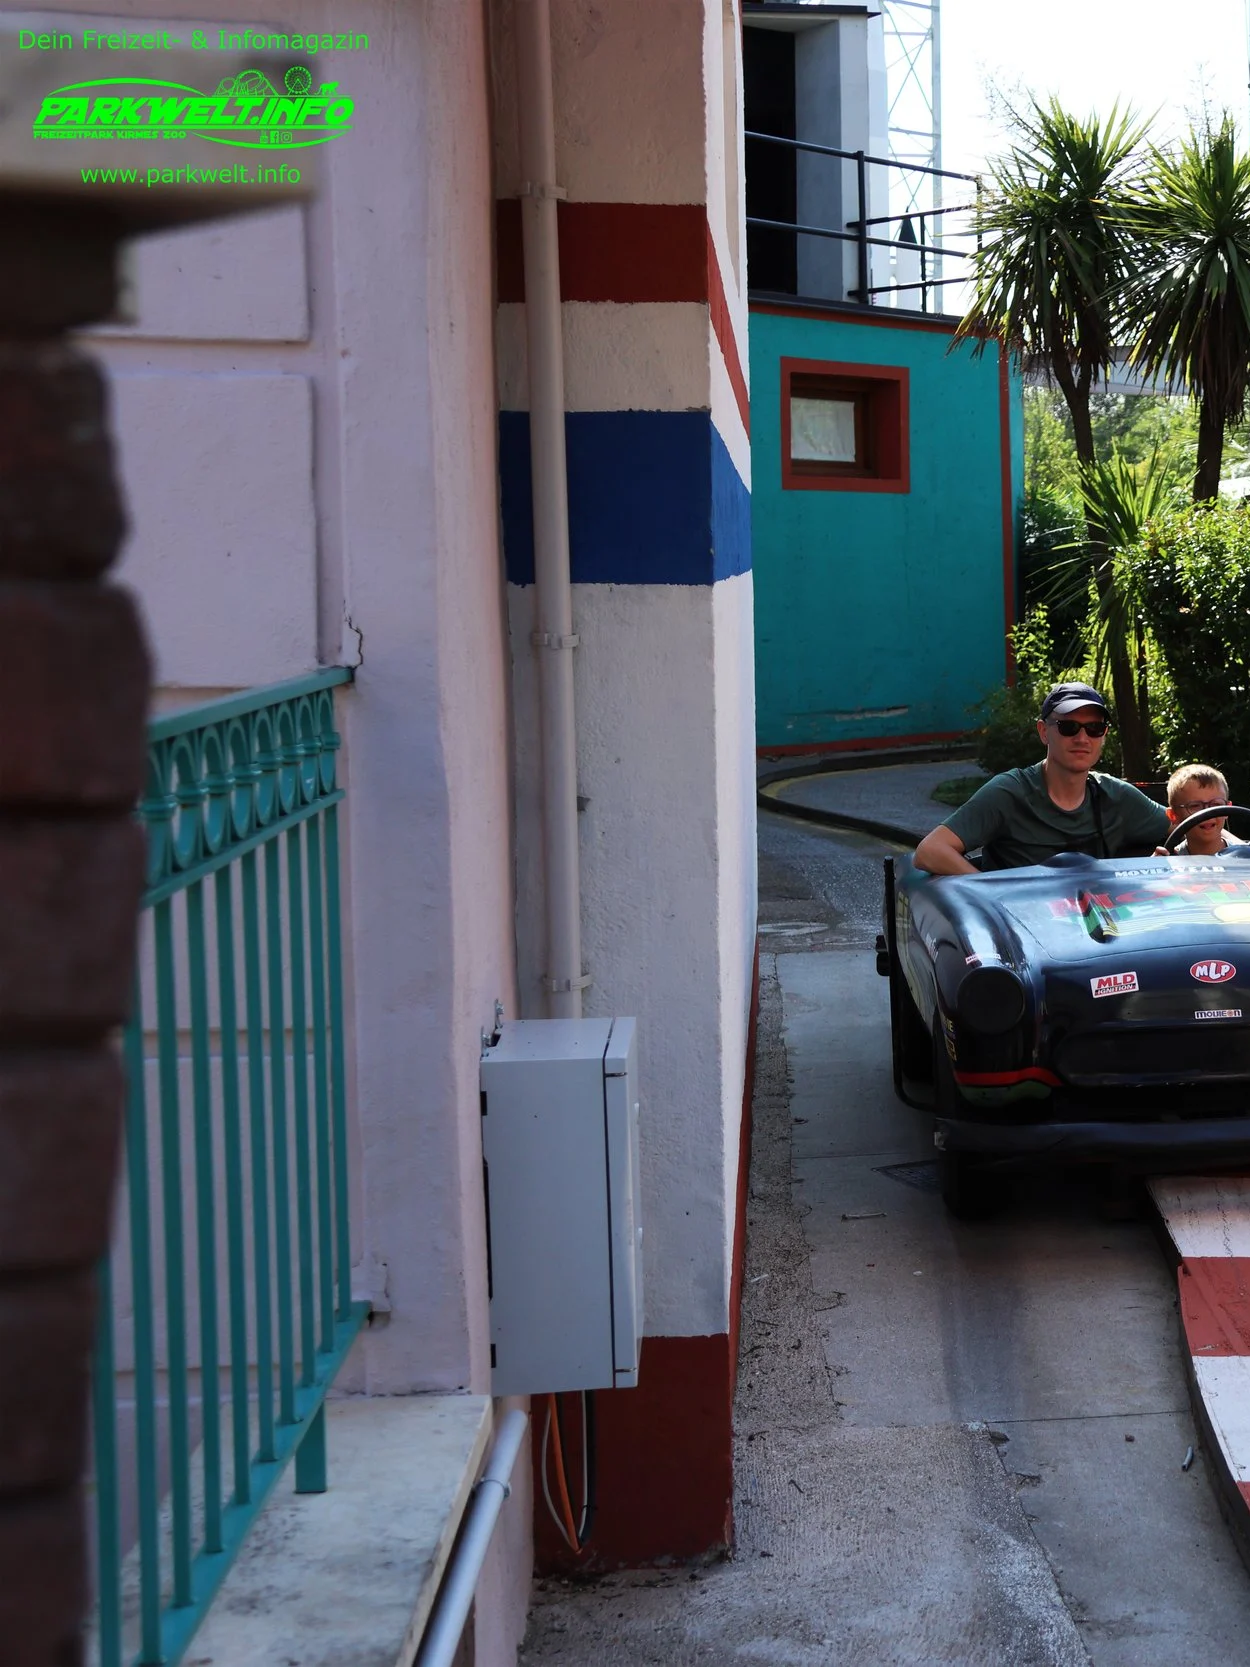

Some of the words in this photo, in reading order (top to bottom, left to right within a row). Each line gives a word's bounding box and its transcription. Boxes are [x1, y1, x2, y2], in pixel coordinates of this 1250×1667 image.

[1195, 962, 1230, 980] MLP
[1097, 973, 1135, 989] MLD
[1096, 984, 1135, 995] IGNITION
